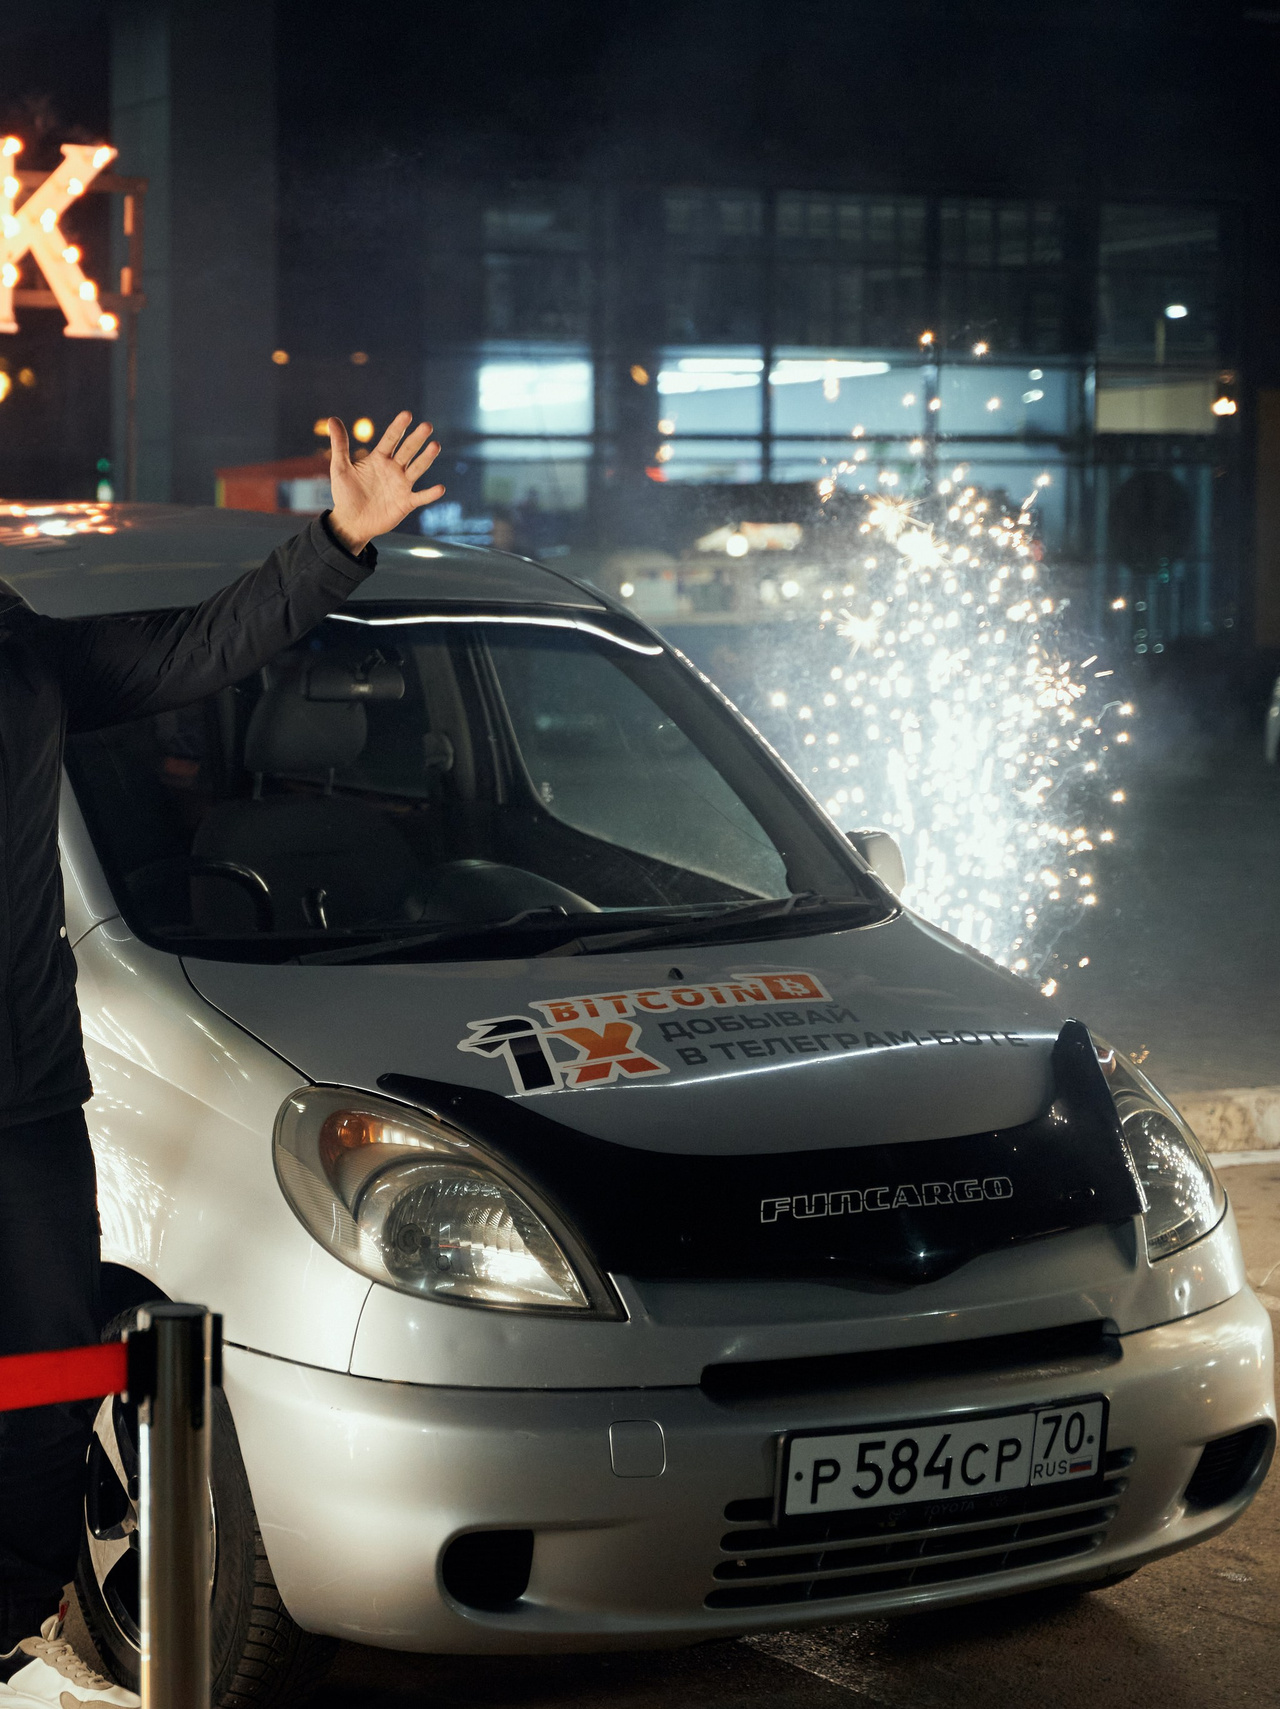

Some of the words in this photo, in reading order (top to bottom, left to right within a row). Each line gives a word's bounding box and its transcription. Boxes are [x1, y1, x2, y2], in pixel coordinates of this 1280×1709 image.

[545, 983, 769, 1023] BITCOIN
[657, 1003, 861, 1042] ДОБЫВАЙ
[675, 1046, 709, 1067] В
[709, 1029, 1029, 1061] ТЕЛЕГРАМ-БОТЕ
[761, 1175, 1014, 1223] FUNCARGO
[1041, 1411, 1086, 1460] 70
[1032, 1457, 1068, 1479] RUS
